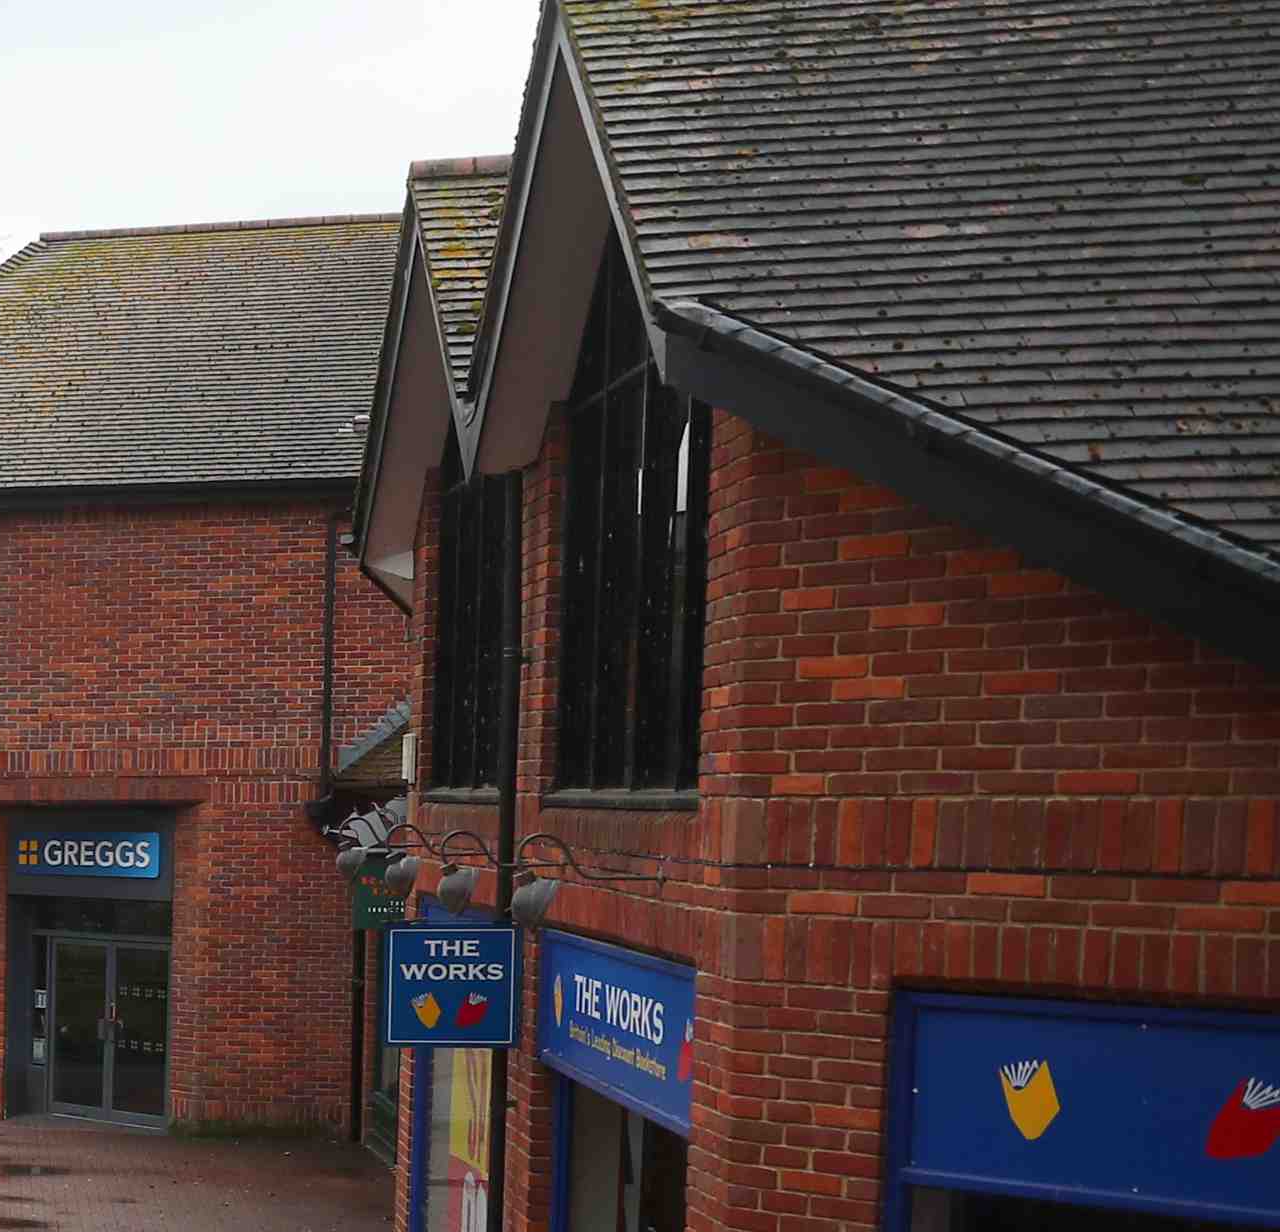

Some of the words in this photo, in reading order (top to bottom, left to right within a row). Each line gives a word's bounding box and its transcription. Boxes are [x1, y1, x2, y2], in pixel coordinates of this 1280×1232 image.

[43, 840, 152, 868] GREGGS
[424, 940, 480, 957] THE
[400, 964, 504, 982] WORKS
[574, 974, 601, 1019] THE
[605, 983, 664, 1046] WORKS
